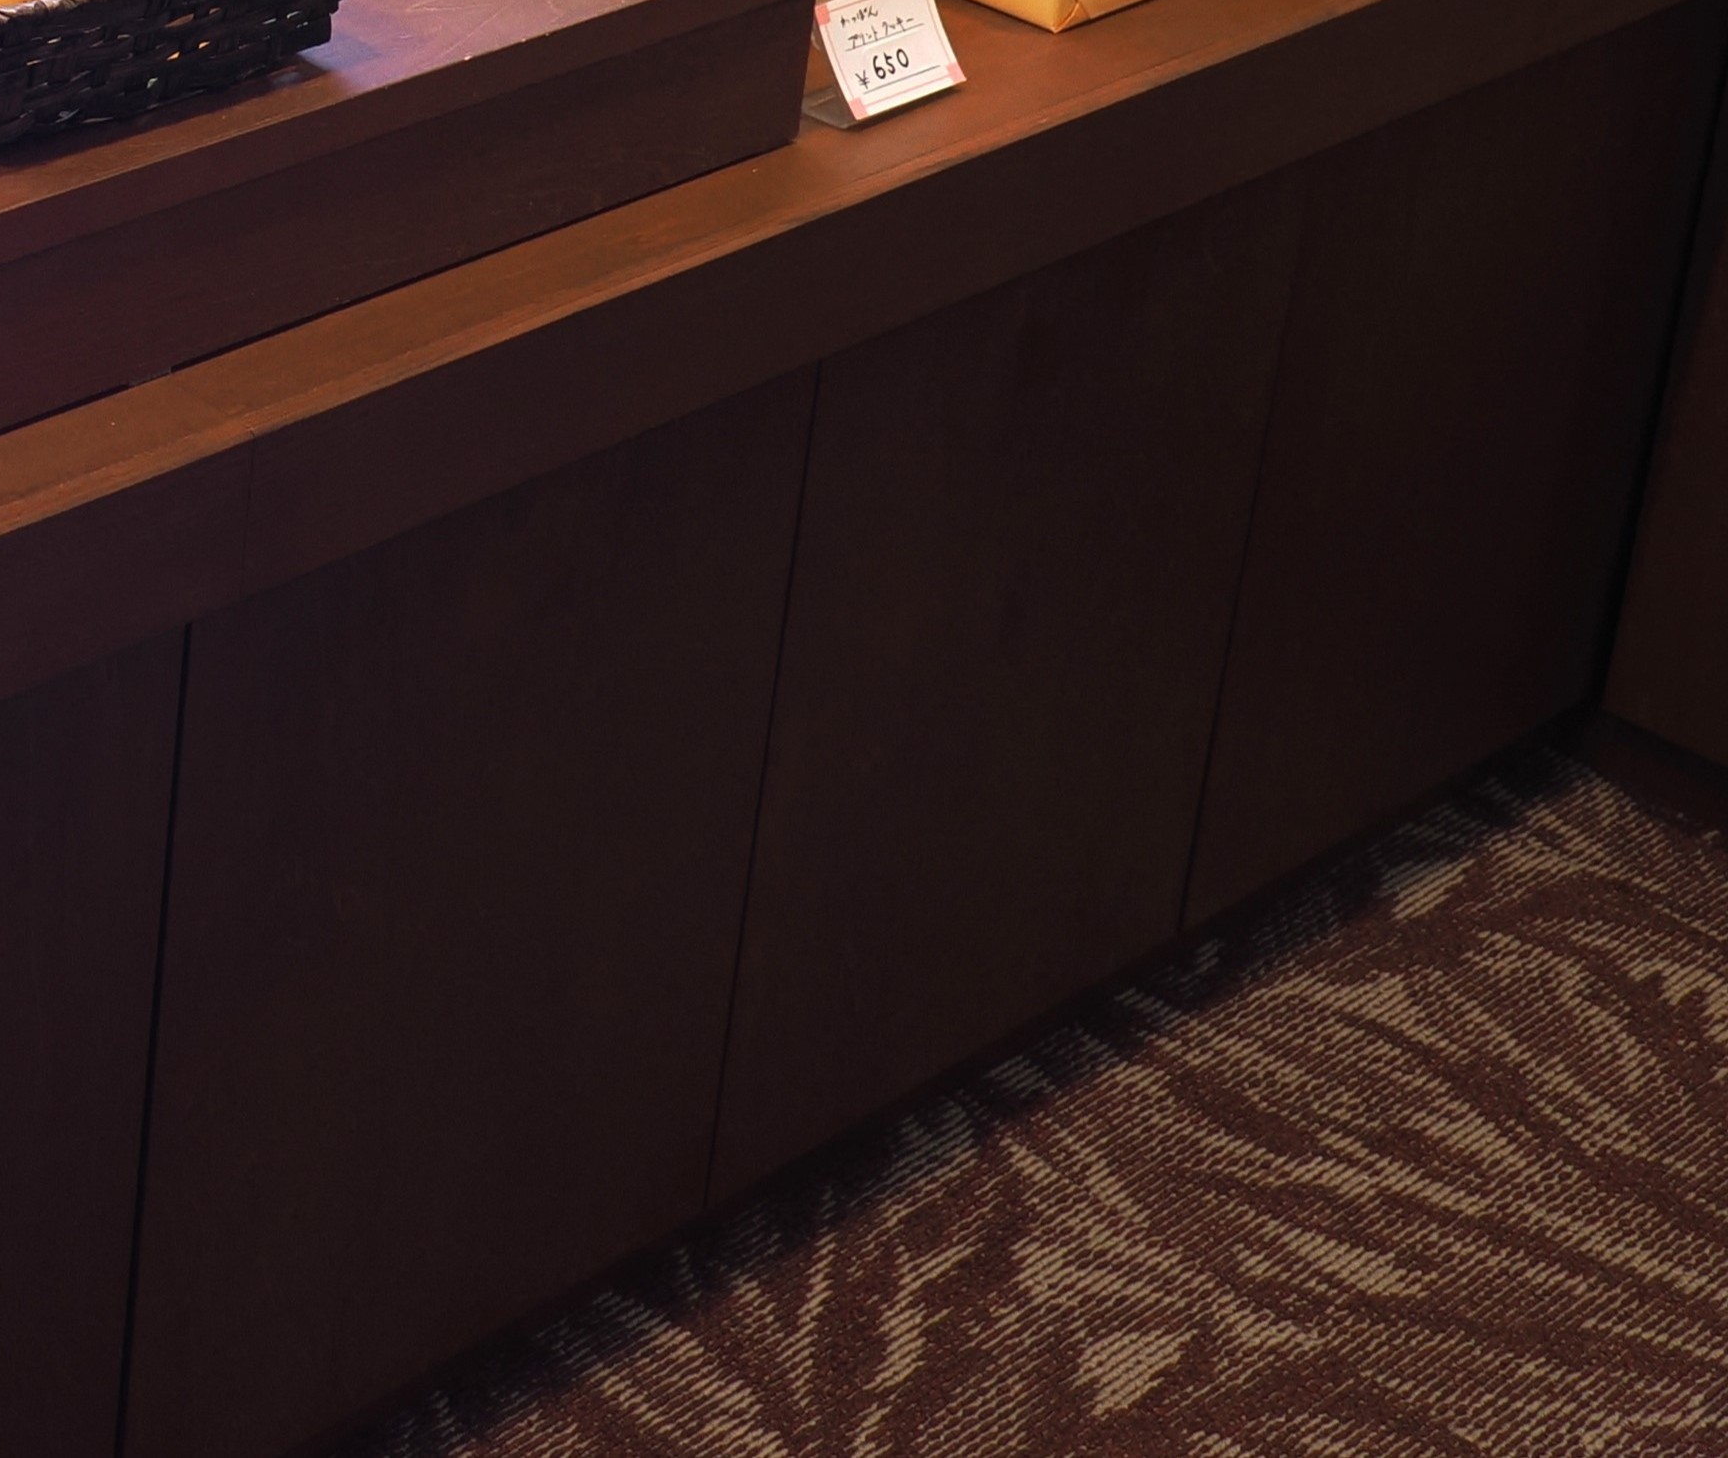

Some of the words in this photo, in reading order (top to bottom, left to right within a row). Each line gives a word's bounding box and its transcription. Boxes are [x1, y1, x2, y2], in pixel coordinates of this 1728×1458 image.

[840, 6, 879, 29] かっぽん
[856, 47, 910, 89] ¥650
